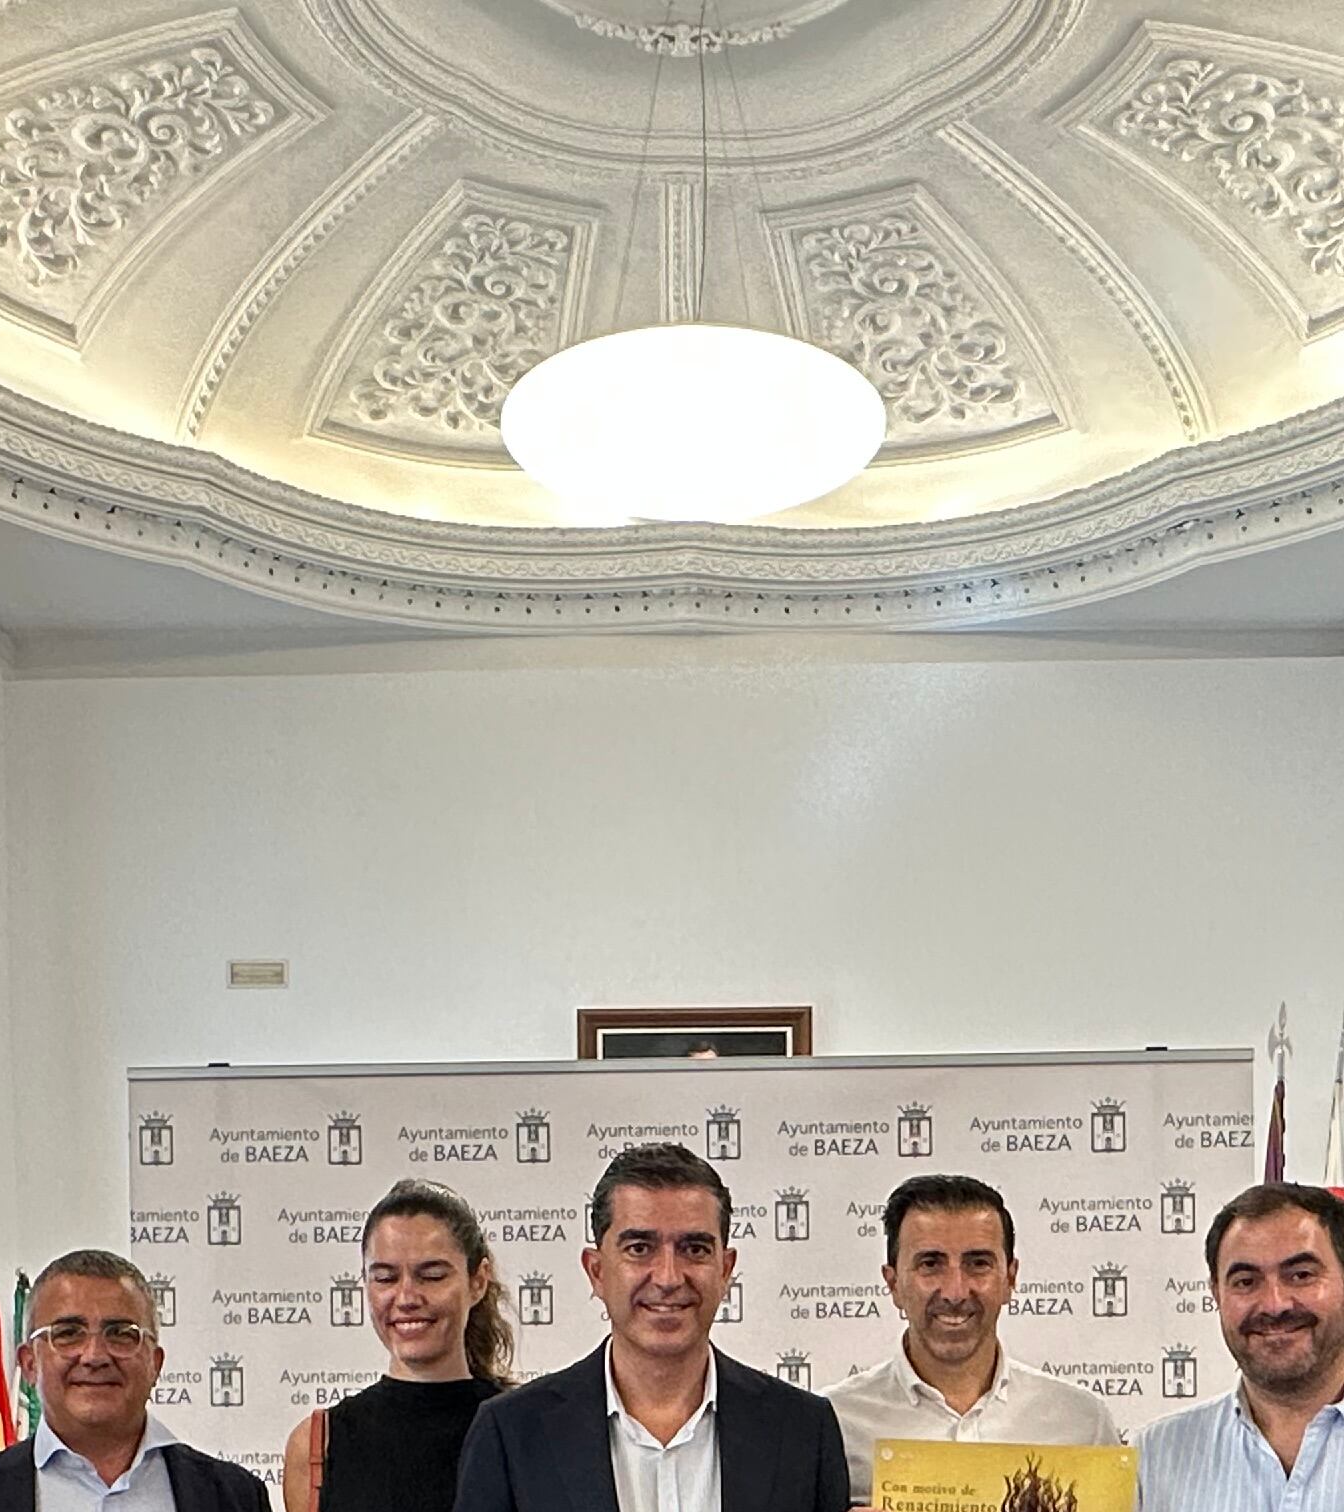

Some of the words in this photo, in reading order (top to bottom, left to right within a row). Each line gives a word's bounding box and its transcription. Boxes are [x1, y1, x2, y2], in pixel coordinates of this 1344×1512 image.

[777, 1120, 890, 1137] Ayuntamiento
[969, 1116, 1084, 1133] Ayuntamiento
[1163, 1112, 1254, 1129] Ayuntamie
[209, 1127, 320, 1144] Ayuntamiento
[398, 1125, 508, 1142] Ayuntamiento
[587, 1123, 699, 1140] Ayuntamiento
[1174, 1134, 1194, 1149] de
[1200, 1130, 1255, 1148] BAEZ
[789, 1141, 807, 1156] de
[814, 1138, 879, 1156] BAEZA
[981, 1137, 1001, 1152] de
[1006, 1134, 1072, 1152] BAEZA
[220, 1148, 239, 1163] de
[245, 1145, 309, 1162] BAEZA
[409, 1147, 428, 1162] de
[434, 1144, 498, 1162] BAEZA
[1039, 1197, 1153, 1215] Ayuntamiento
[130, 1208, 199, 1223] tamiento
[478, 1206, 577, 1224] yuntamiento
[857, 1222, 877, 1237] de
[1050, 1219, 1070, 1234] de
[1076, 1215, 1142, 1232] BAEZA
[288, 1229, 308, 1244] de
[314, 1226, 362, 1244] BAEZ
[503, 1225, 566, 1242] BAEZA
[212, 1289, 322, 1306] Ayuntamiento
[791, 1305, 809, 1320] de
[816, 1301, 880, 1319] BAEZA
[1008, 1298, 1073, 1316] BAEZA
[1176, 1299, 1196, 1314] de
[223, 1310, 242, 1325] de
[248, 1307, 312, 1324] BAEZA
[280, 1369, 379, 1386] Ayuntamient
[291, 1390, 310, 1406] de
[882, 1481, 907, 1493] Con
[913, 1483, 956, 1495] motivo
[961, 1484, 976, 1496] de
